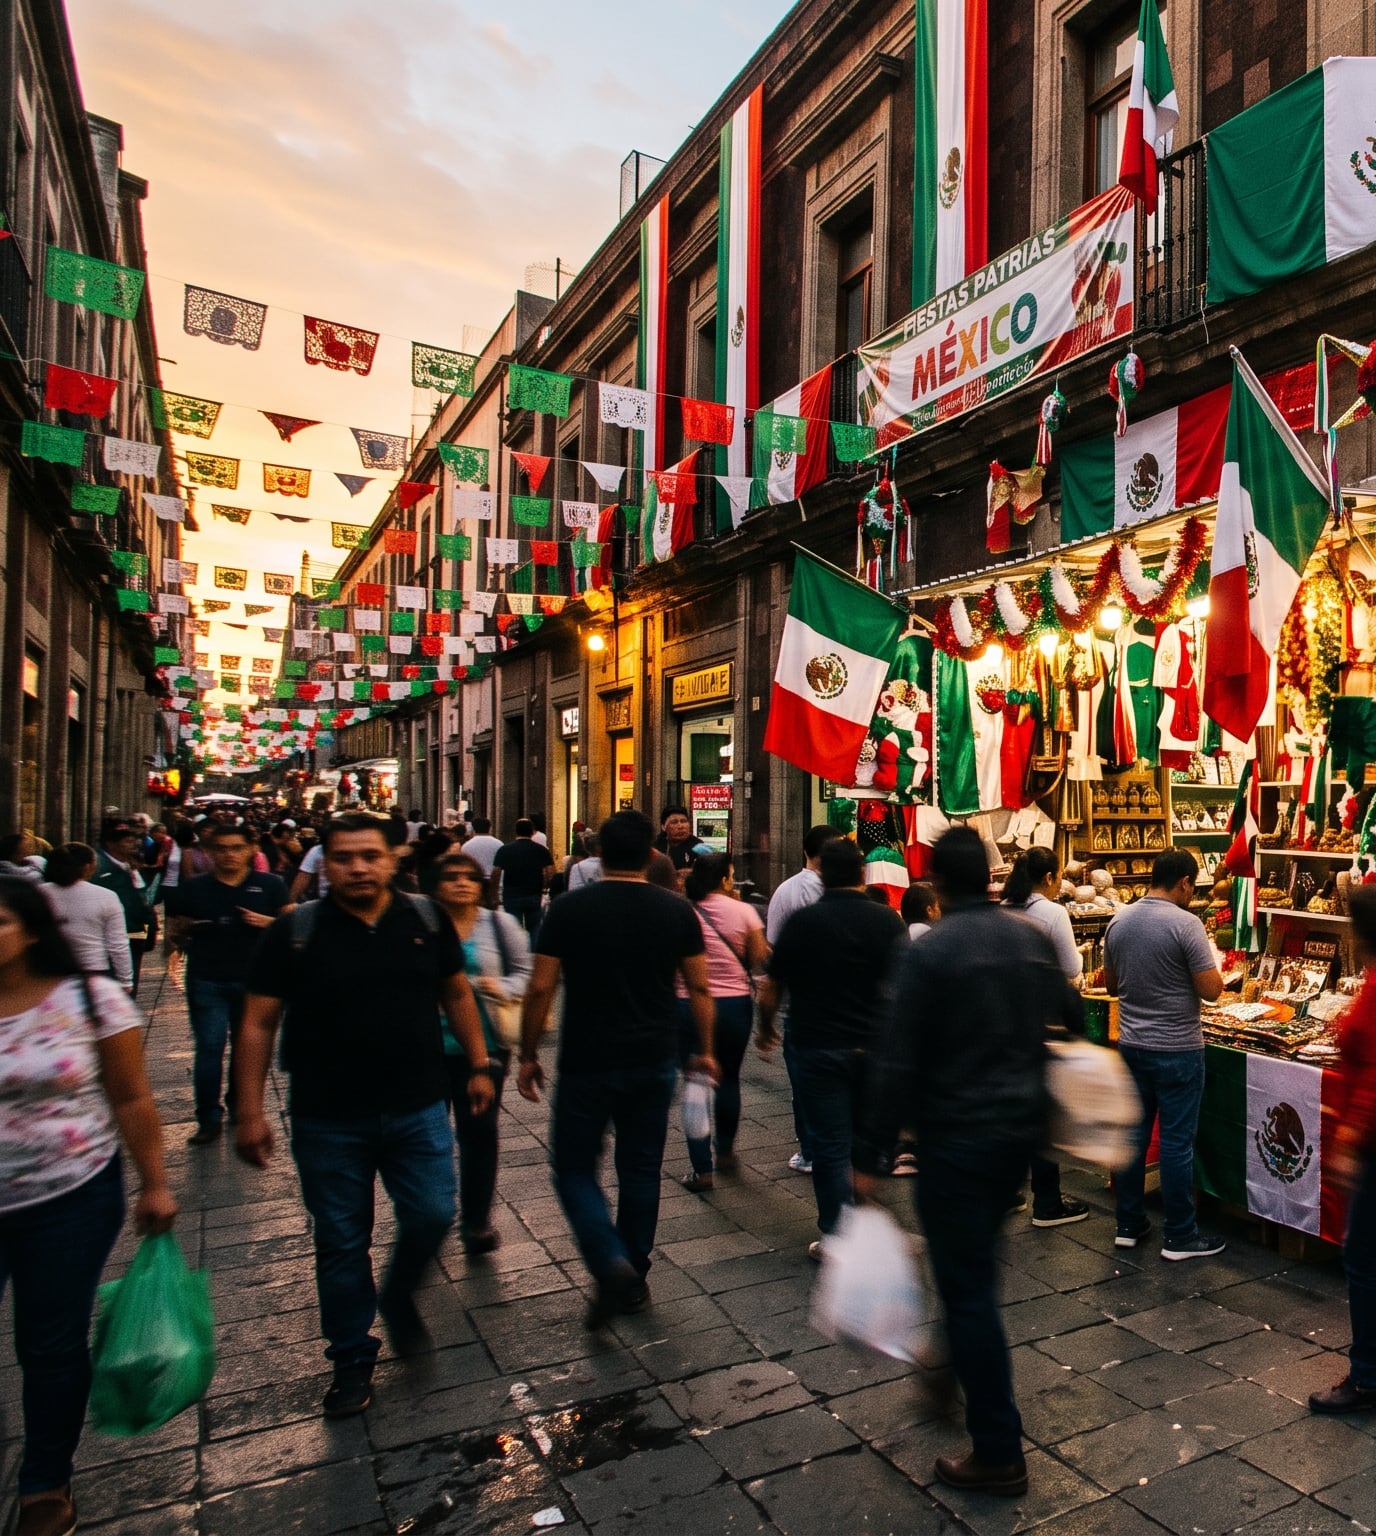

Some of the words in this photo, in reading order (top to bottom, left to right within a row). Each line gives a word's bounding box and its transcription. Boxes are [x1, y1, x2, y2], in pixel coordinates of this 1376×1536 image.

[903, 280, 970, 341] FIESTAS
[973, 227, 1057, 300] PATRIAS
[912, 292, 1038, 401] MÉXICO
